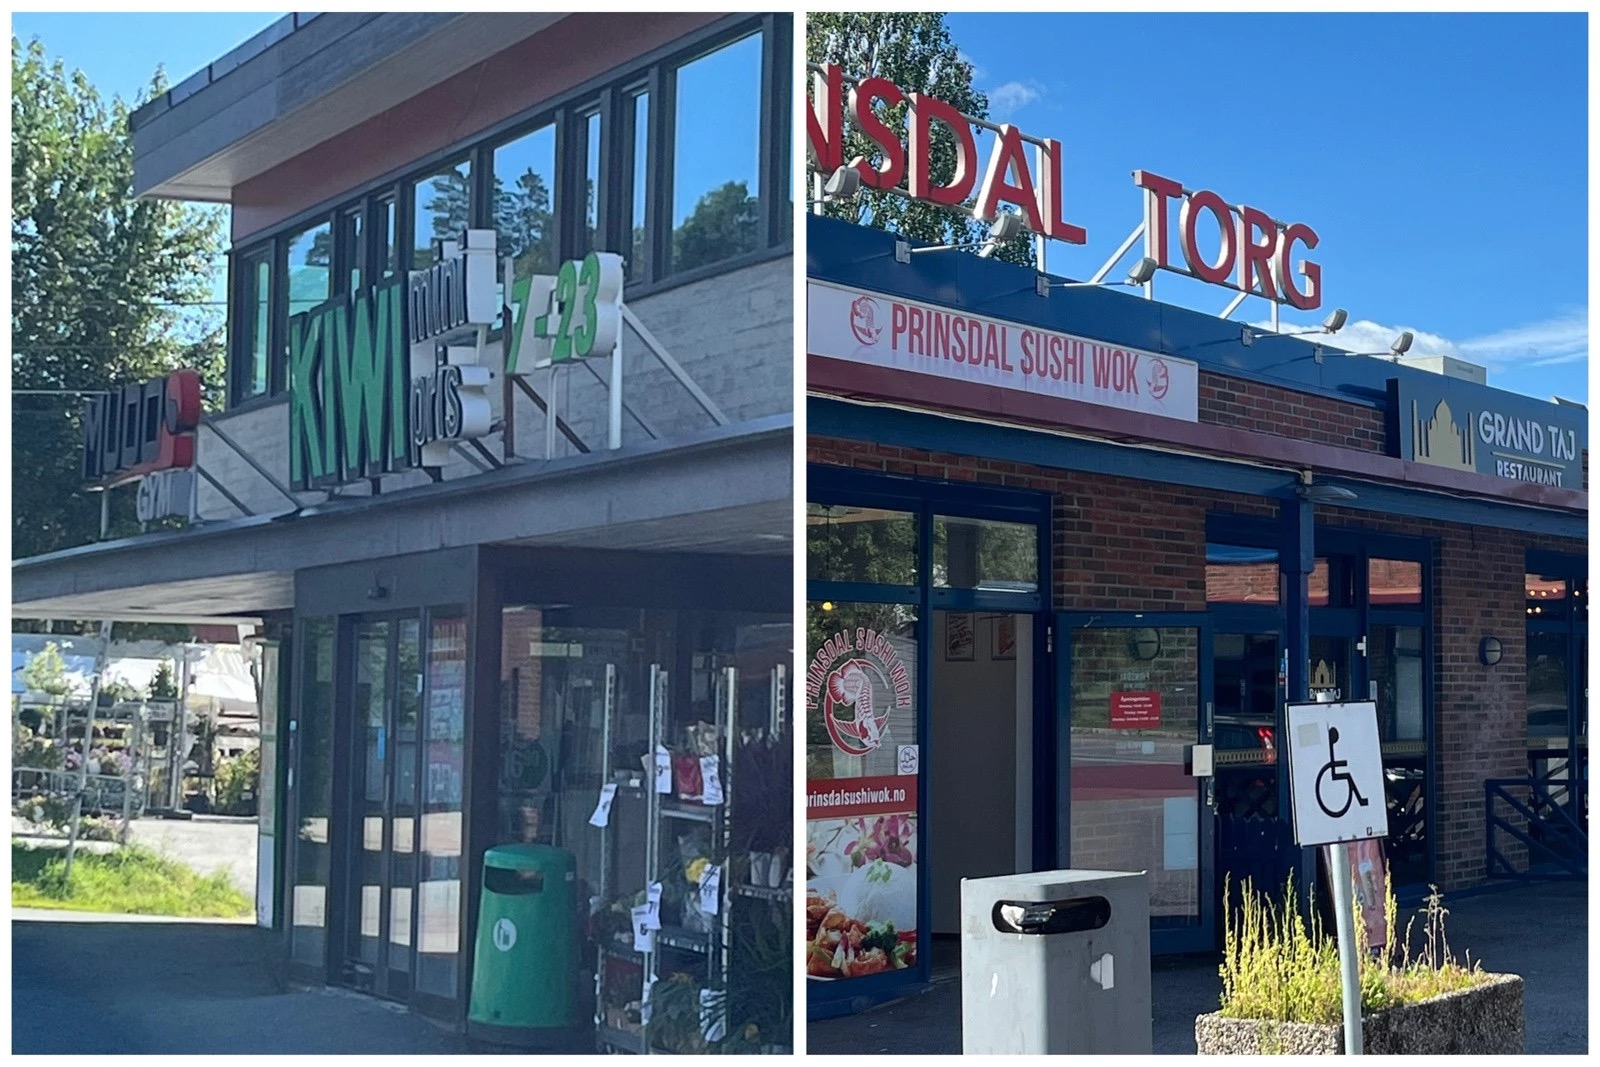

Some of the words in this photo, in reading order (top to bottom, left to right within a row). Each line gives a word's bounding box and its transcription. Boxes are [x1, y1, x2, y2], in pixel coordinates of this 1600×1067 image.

[806, 63, 1086, 245] NSDAL
[1134, 169, 1322, 310] TORG
[289, 277, 409, 489] KIWI
[891, 302, 1014, 372] PRINSDAL
[1020, 329, 1084, 385] SUSHI
[1092, 345, 1139, 395] WOK
[1478, 410, 1544, 454] GRAND
[1547, 425, 1576, 461] TAJ
[1496, 460, 1562, 488] RESTAURANT
[136, 473, 174, 522] GYM
[856, 627, 898, 668] SUSHI
[890, 660, 912, 709] WOK
